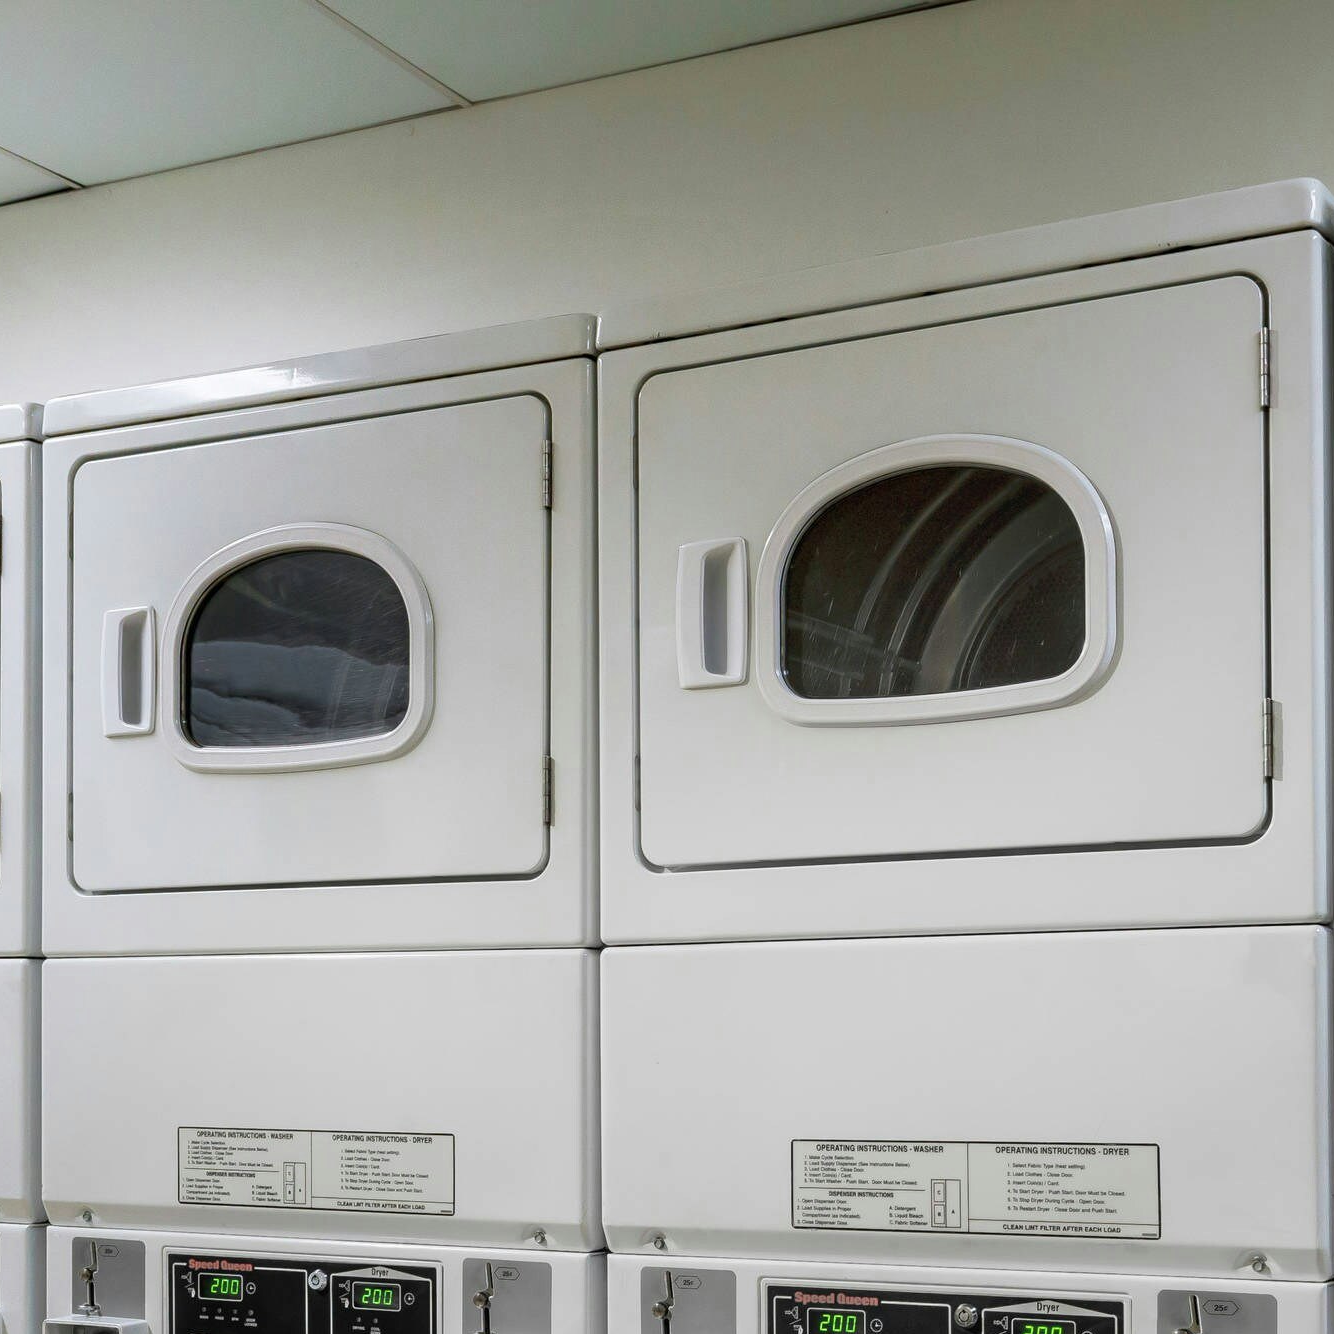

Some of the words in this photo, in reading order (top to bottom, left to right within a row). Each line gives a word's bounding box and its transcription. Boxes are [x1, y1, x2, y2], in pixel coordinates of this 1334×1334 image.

[366, 1135, 407, 1143] INSTRUCTIONS
[1041, 1147, 1096, 1155] INSTRUCTIONS
[188, 1259, 219, 1270] Speed
[221, 1260, 252, 1271] Queen
[372, 1268, 388, 1277] Dryer
[211, 1278, 239, 1294] 200
[362, 1288, 393, 1305] 200
[794, 1291, 835, 1305] Speed
[837, 1293, 878, 1306] Queen
[1036, 1302, 1059, 1312] Dryer
[820, 1314, 857, 1333] 200
